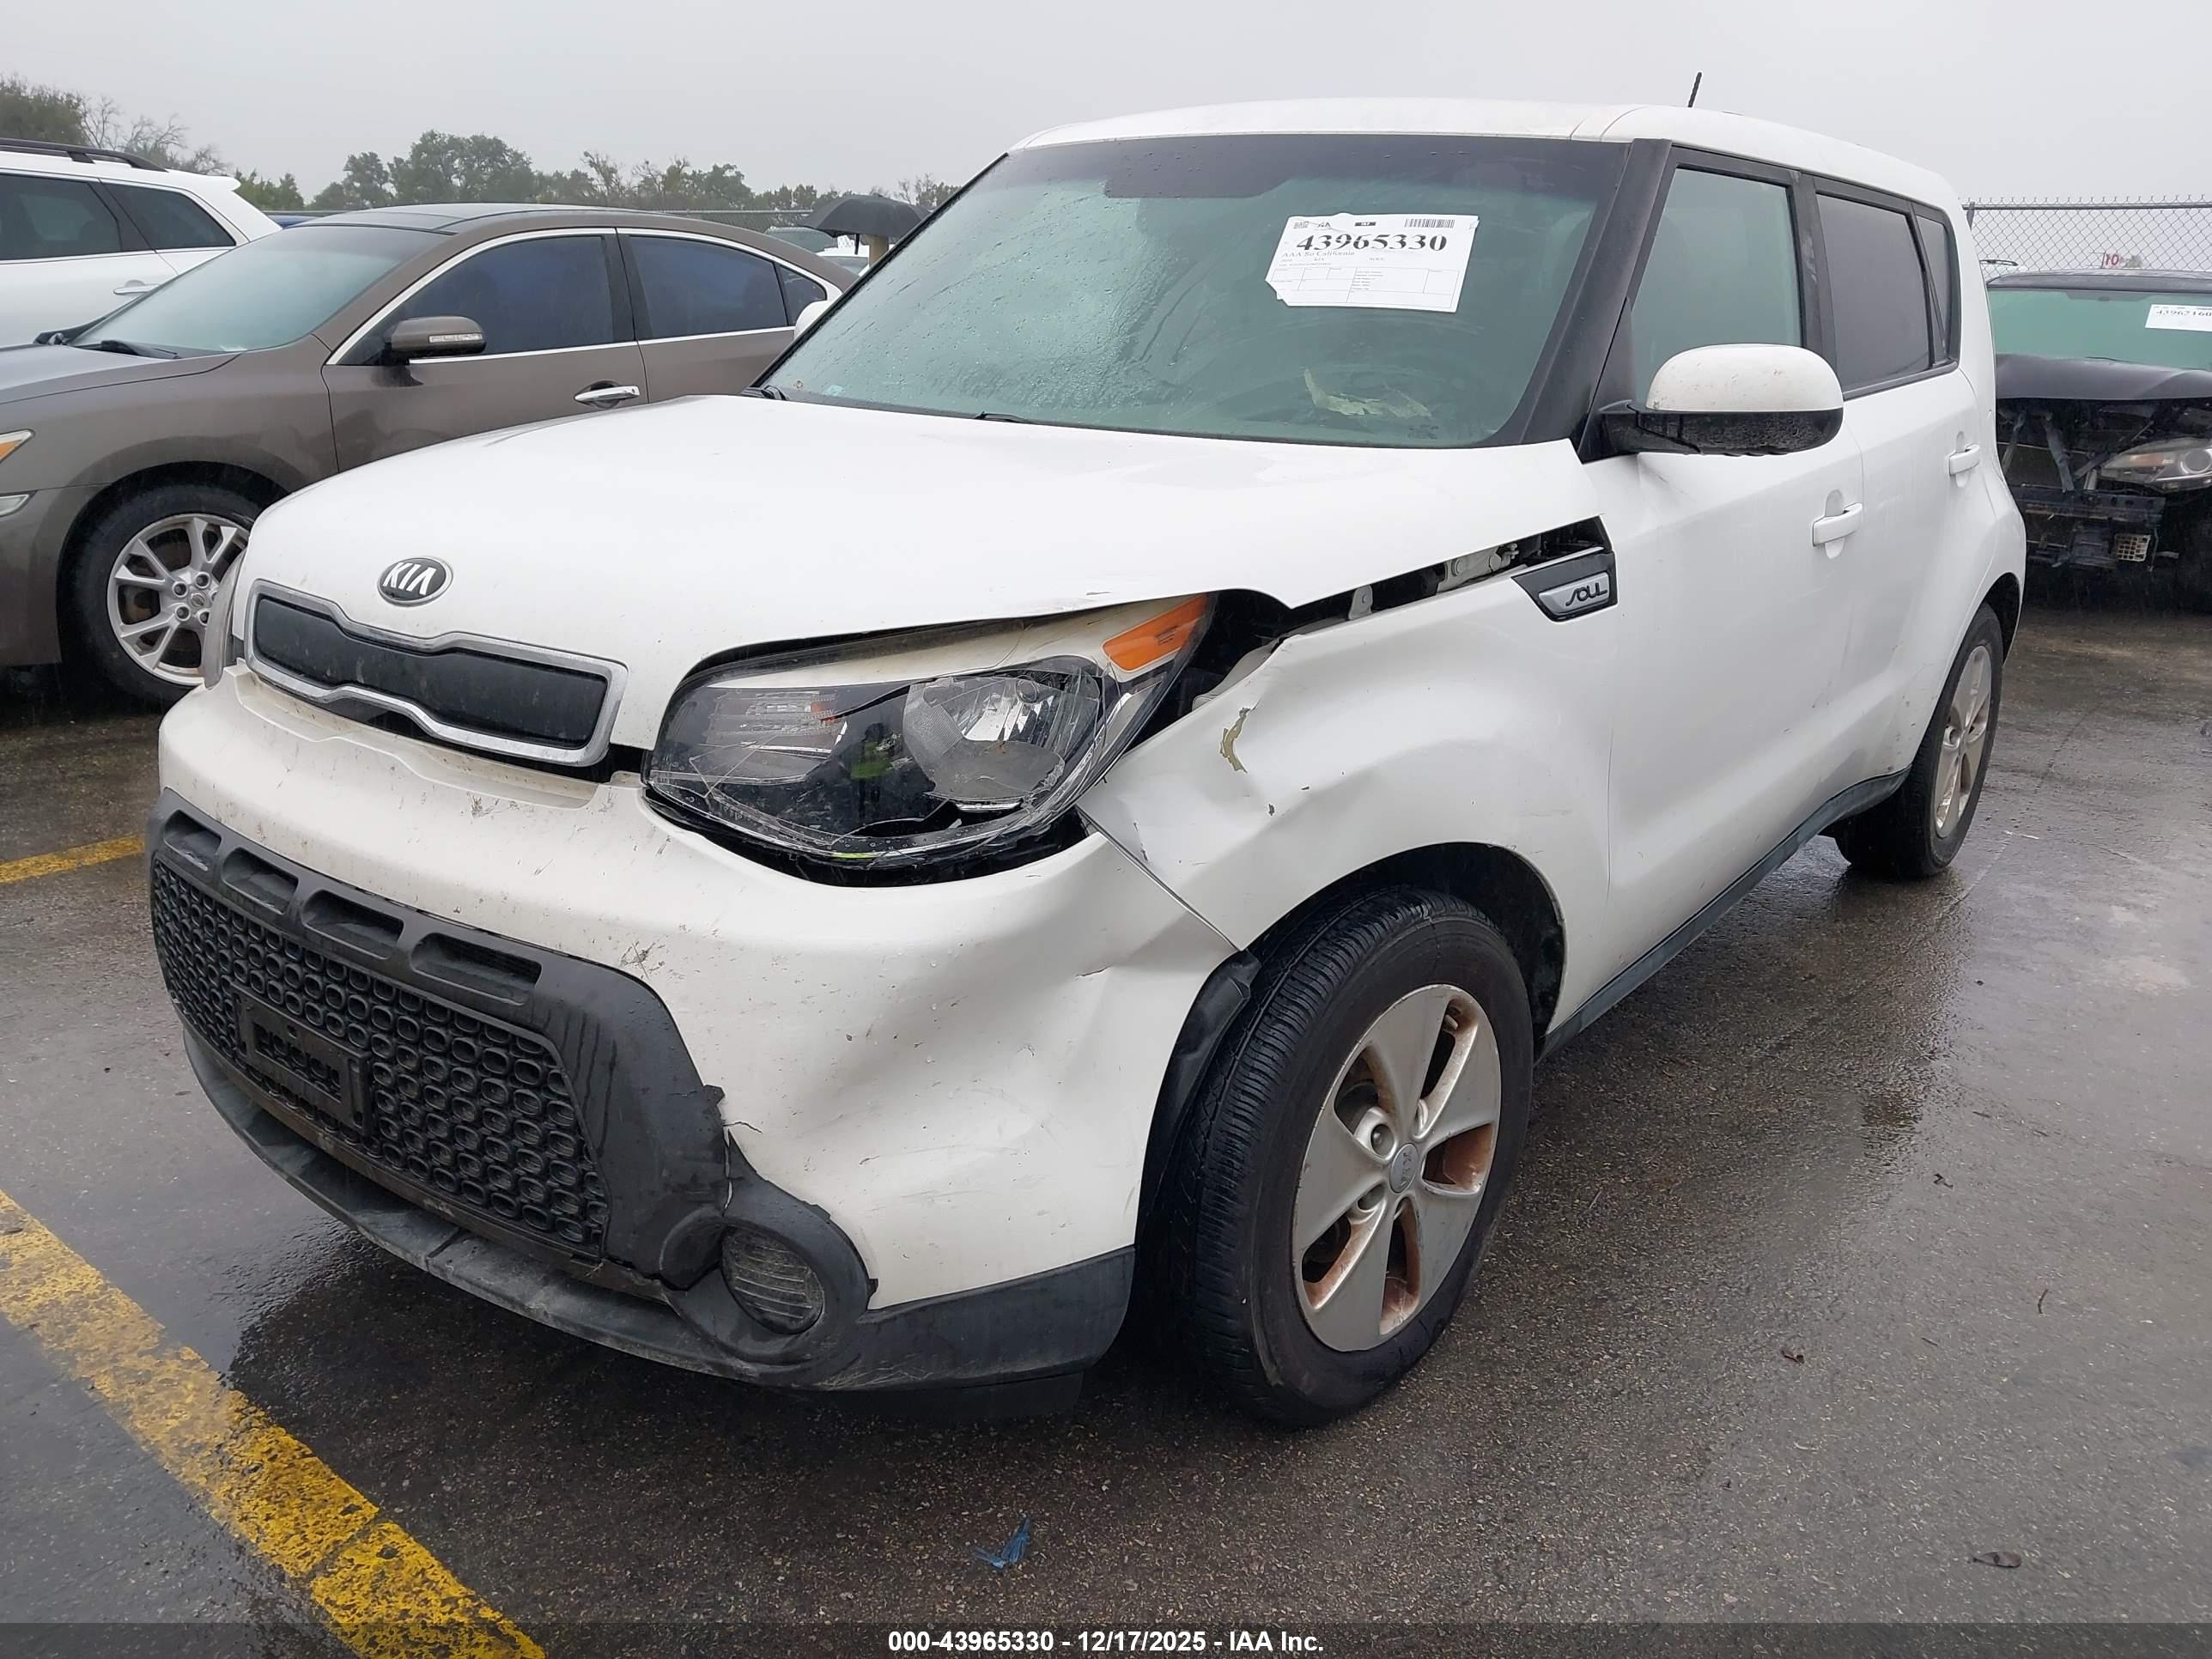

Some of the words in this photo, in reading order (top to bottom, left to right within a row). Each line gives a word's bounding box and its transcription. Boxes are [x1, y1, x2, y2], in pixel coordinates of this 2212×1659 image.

[1296, 234, 1448, 252] 43965330
[382, 562, 437, 595] KIA
[1565, 582, 1608, 606] SOUL
